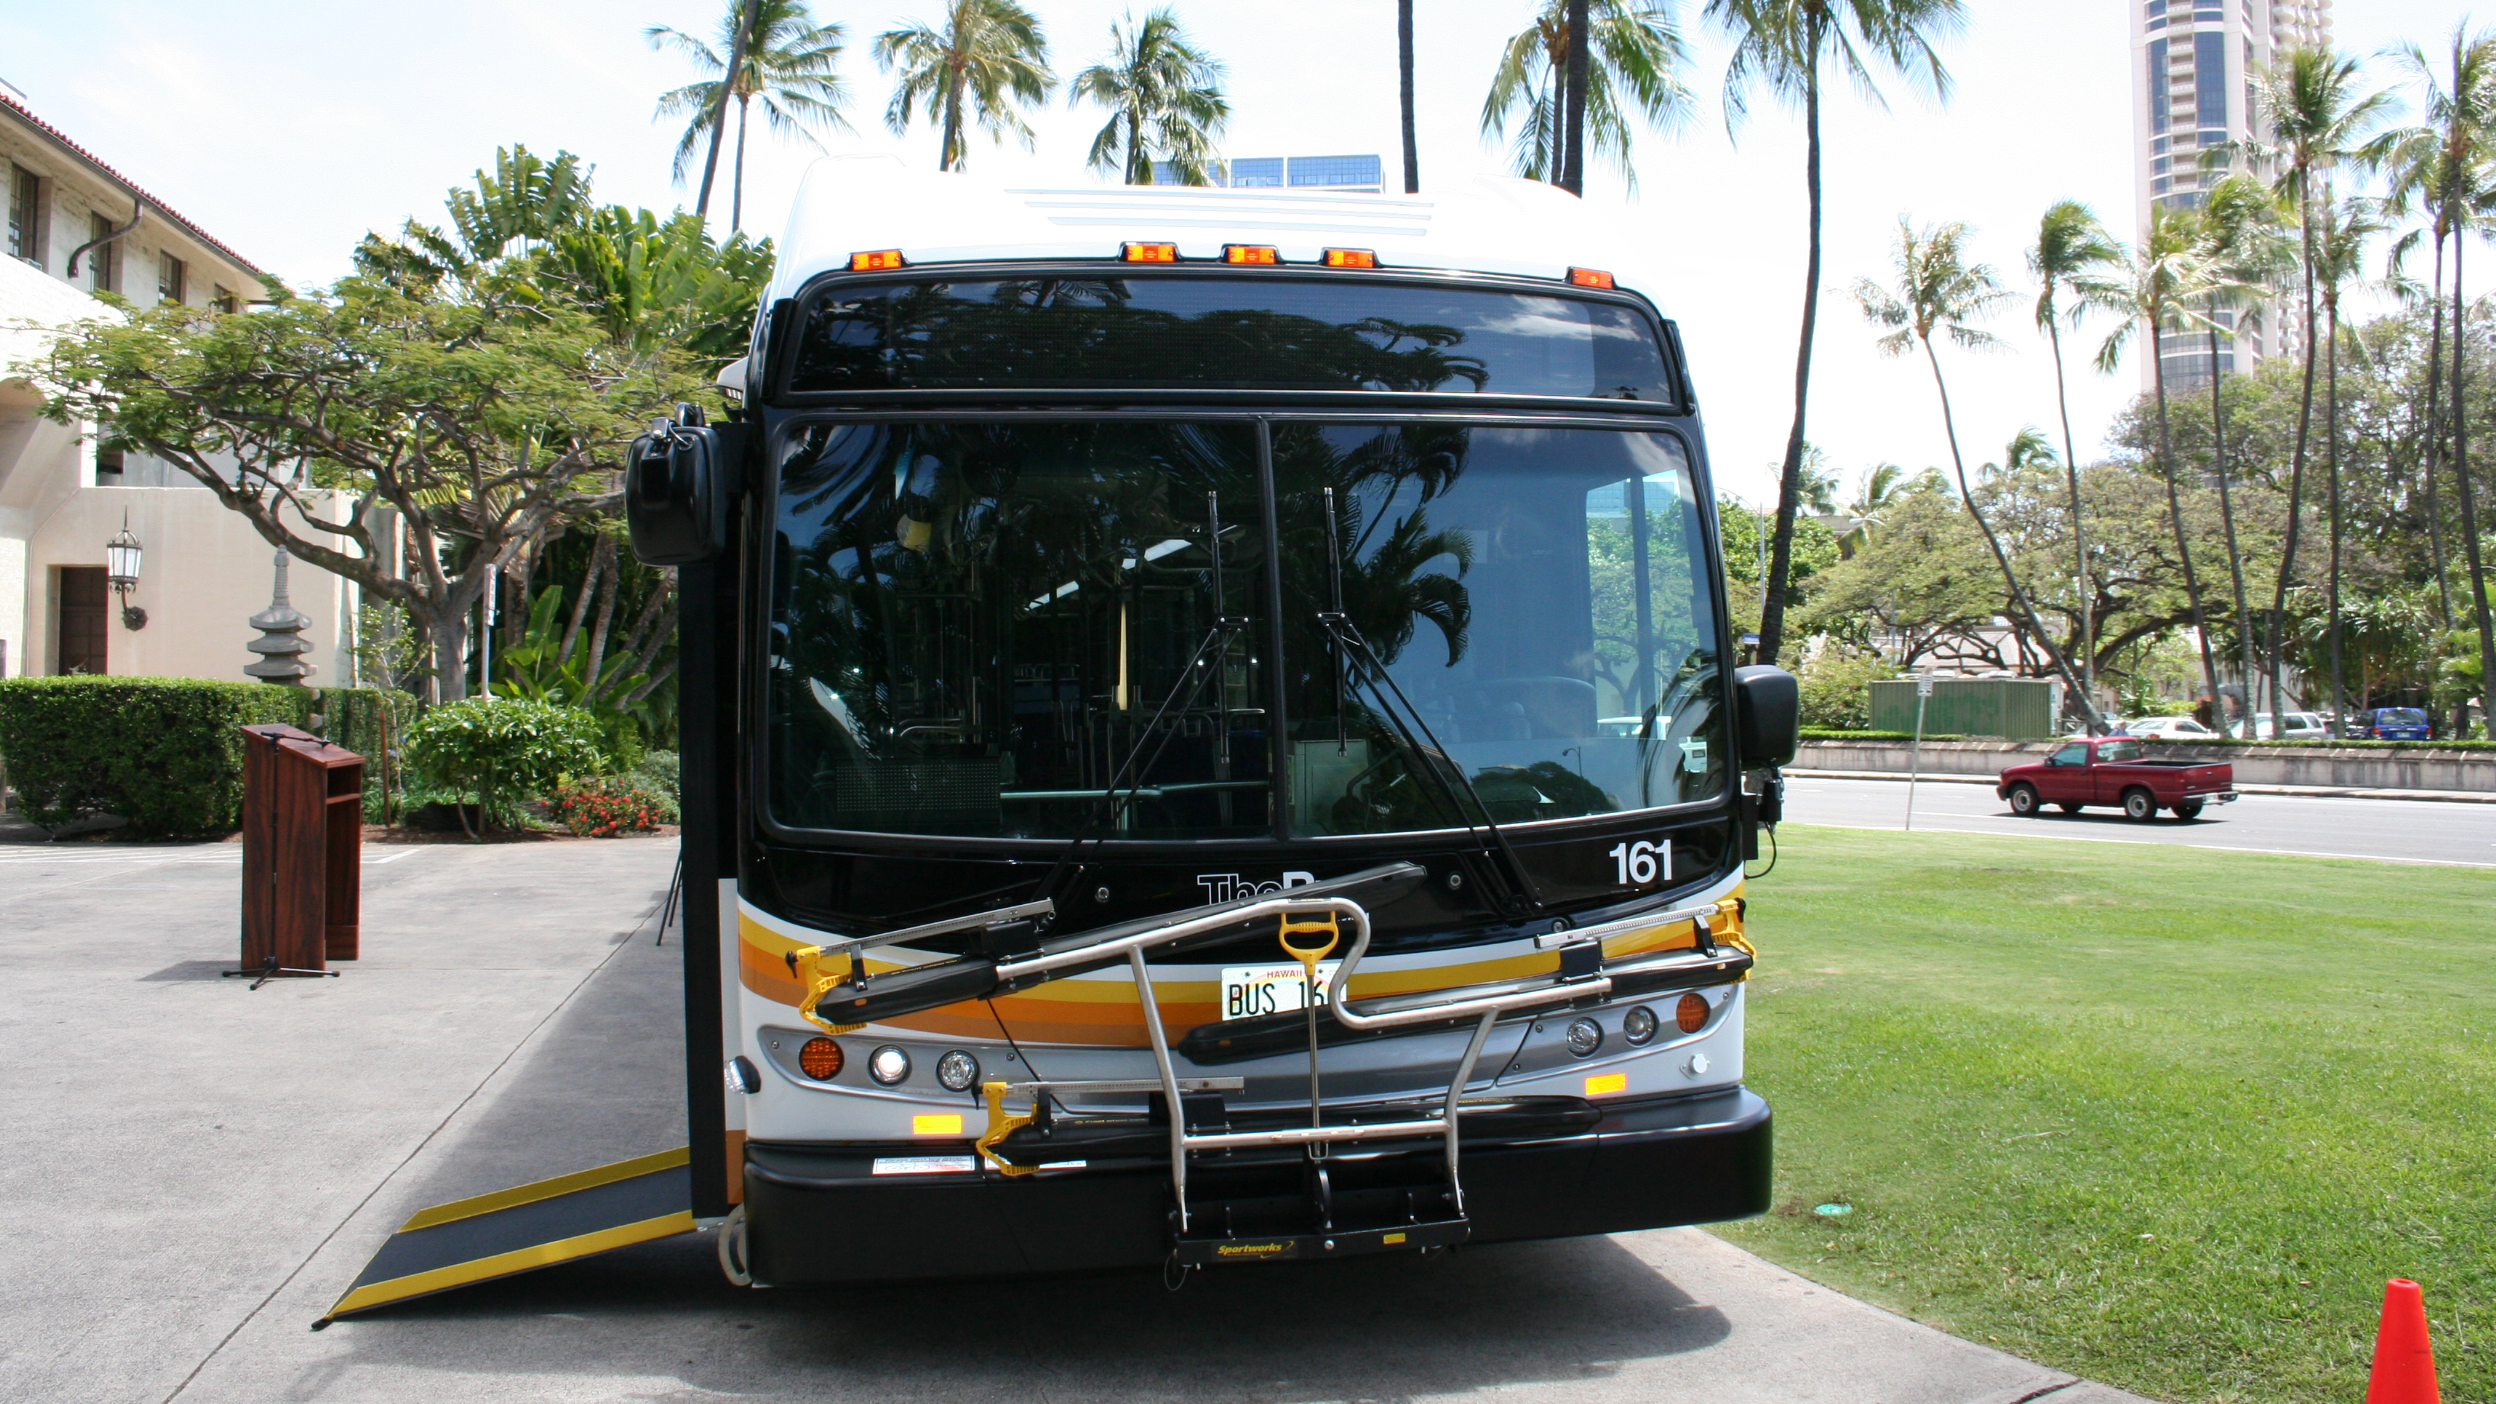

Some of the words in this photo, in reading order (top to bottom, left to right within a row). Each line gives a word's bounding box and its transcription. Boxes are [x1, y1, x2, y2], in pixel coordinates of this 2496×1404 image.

[1608, 838, 1673, 885] 161
[1266, 969, 1303, 979] HAWAII
[1228, 983, 1276, 1016] BUS
[1298, 980, 1326, 1009] 16
[1217, 1243, 1283, 1256] Sportworks
